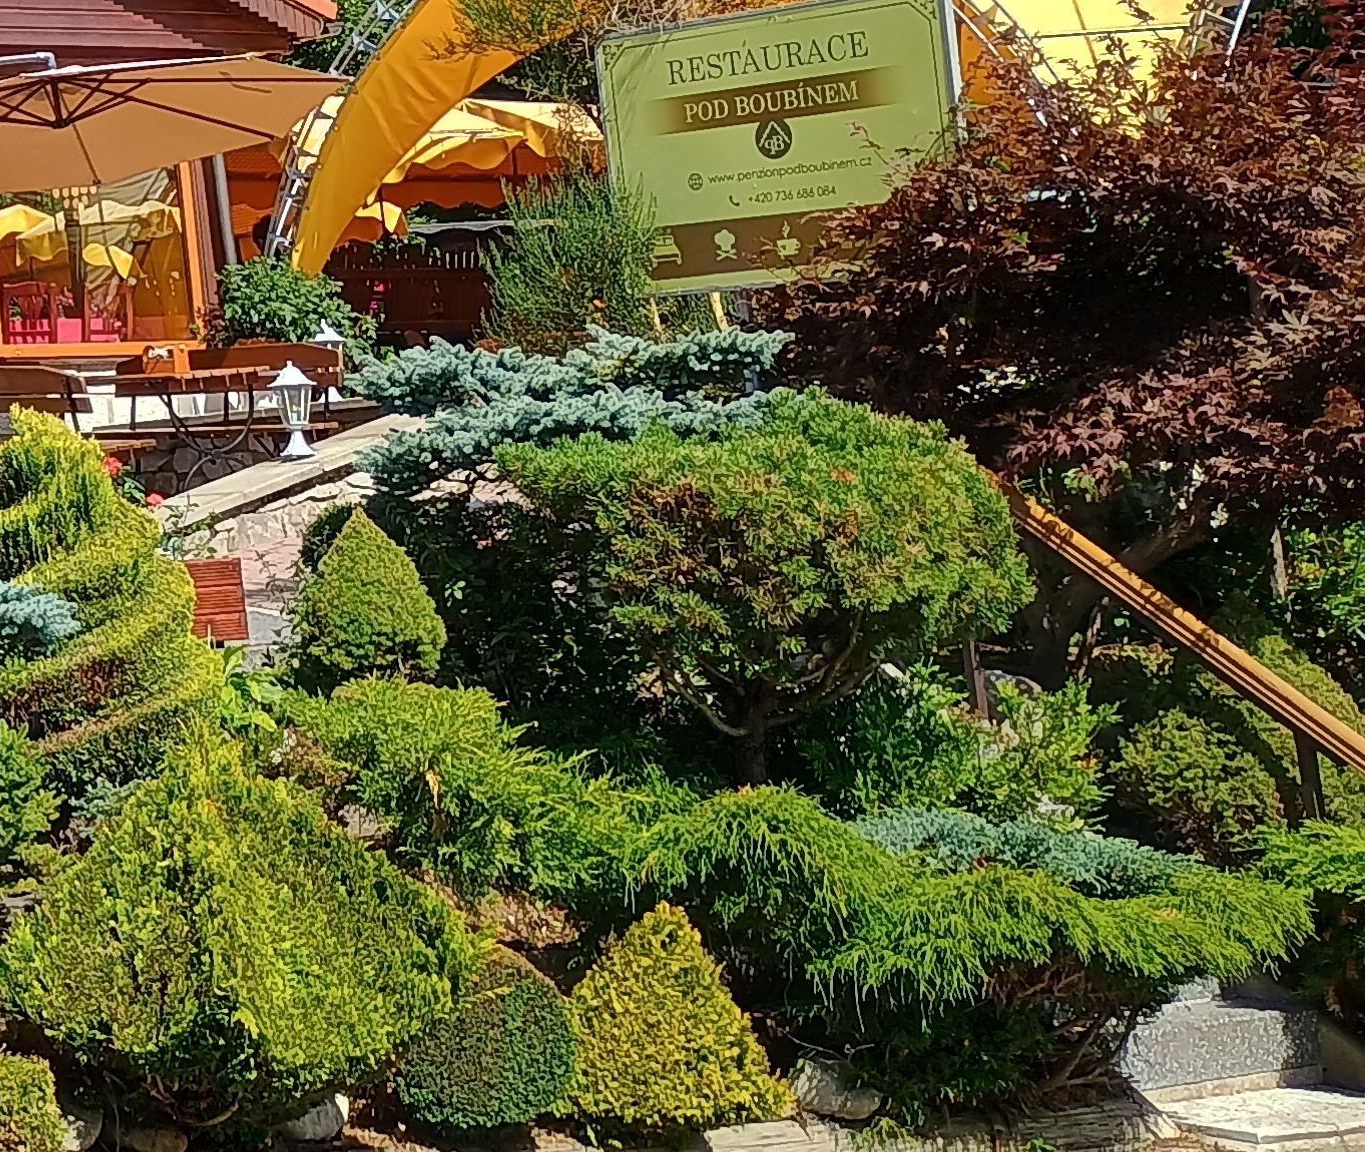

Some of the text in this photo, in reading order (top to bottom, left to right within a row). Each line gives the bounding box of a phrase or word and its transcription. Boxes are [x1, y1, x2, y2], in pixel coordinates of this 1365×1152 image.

[684, 80, 860, 123] POD BOUBÍNEM
[748, 189, 773, 204] +420
[775, 188, 794, 202] 736
[817, 184, 837, 198] 084
